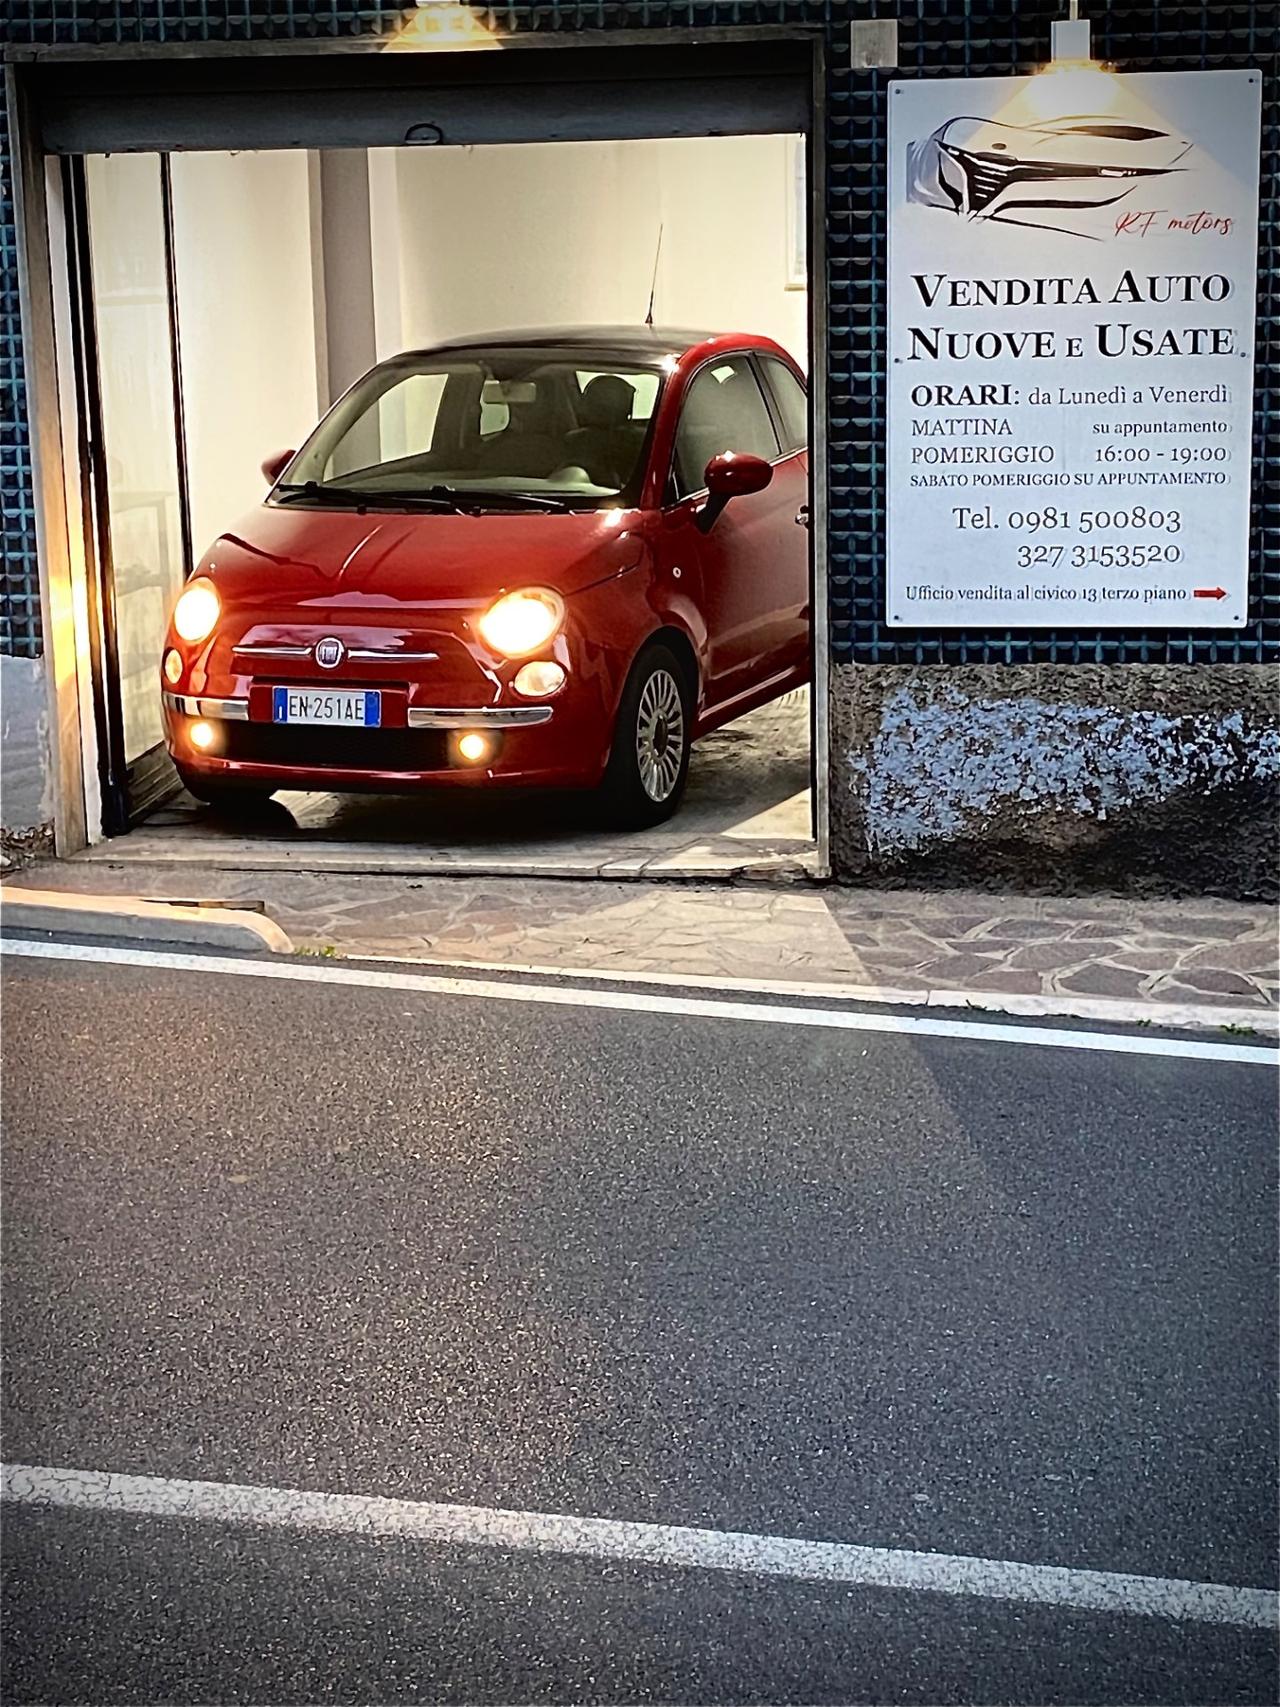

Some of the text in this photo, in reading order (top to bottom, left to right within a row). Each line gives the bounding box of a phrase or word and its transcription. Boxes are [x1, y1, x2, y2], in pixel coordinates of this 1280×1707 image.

[1167, 210, 1231, 235] motors
[911, 384, 1228, 406] ORARI: da Lunedì a Venerdì
[911, 418, 1228, 437] MATTINA su appuntamento
[911, 446, 1055, 464] POMERIGGIO
[1095, 444, 1150, 462] 16:00
[1169, 447, 1227, 465] 19:00
[910, 472, 1226, 487] SABATO POMERIGGIO SU APPUNTAMENTO
[952, 505, 1181, 534] Tel. 0981 500803
[1017, 545, 1180, 568] 327 3153520
[905, 585, 1187, 603] Ufficio vendita al civico 13 terzo piano
